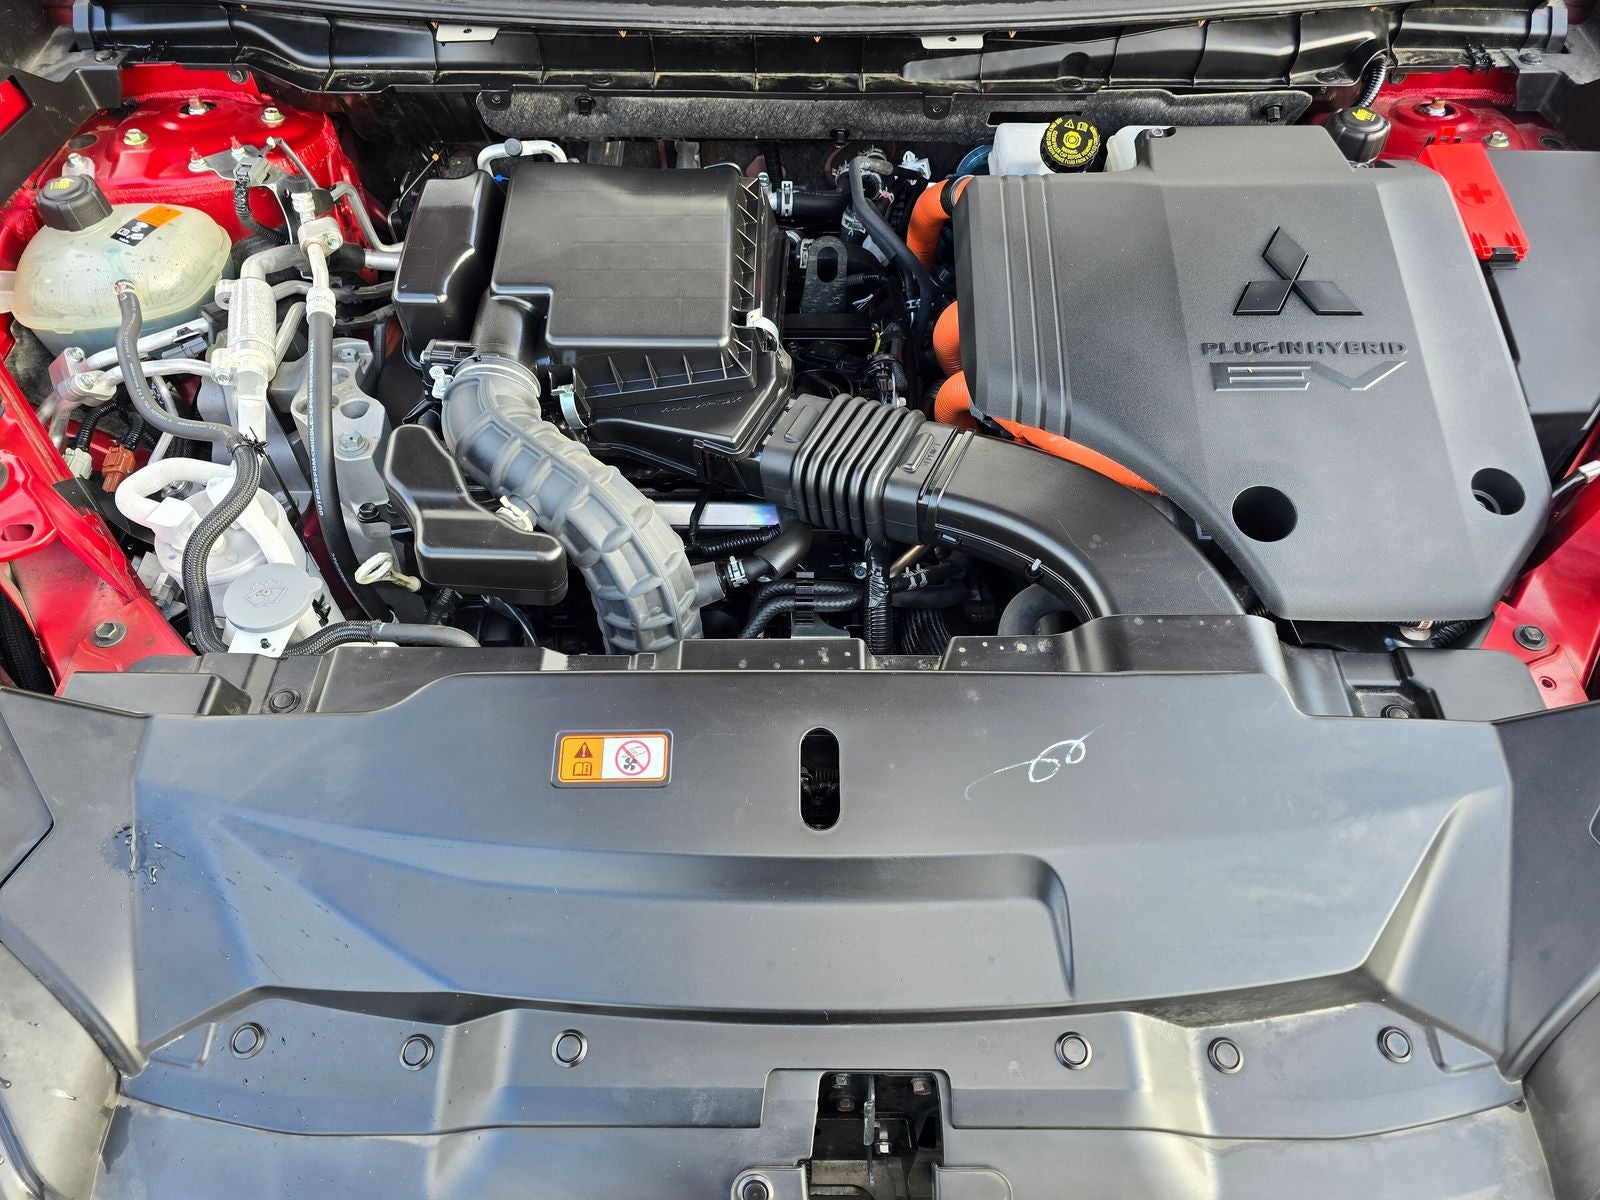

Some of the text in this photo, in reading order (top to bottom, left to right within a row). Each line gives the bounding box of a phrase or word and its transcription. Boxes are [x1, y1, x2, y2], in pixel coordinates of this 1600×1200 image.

[1200, 341, 1408, 356] PLUG-IN HYBRID
[1209, 361, 1408, 392] EV
